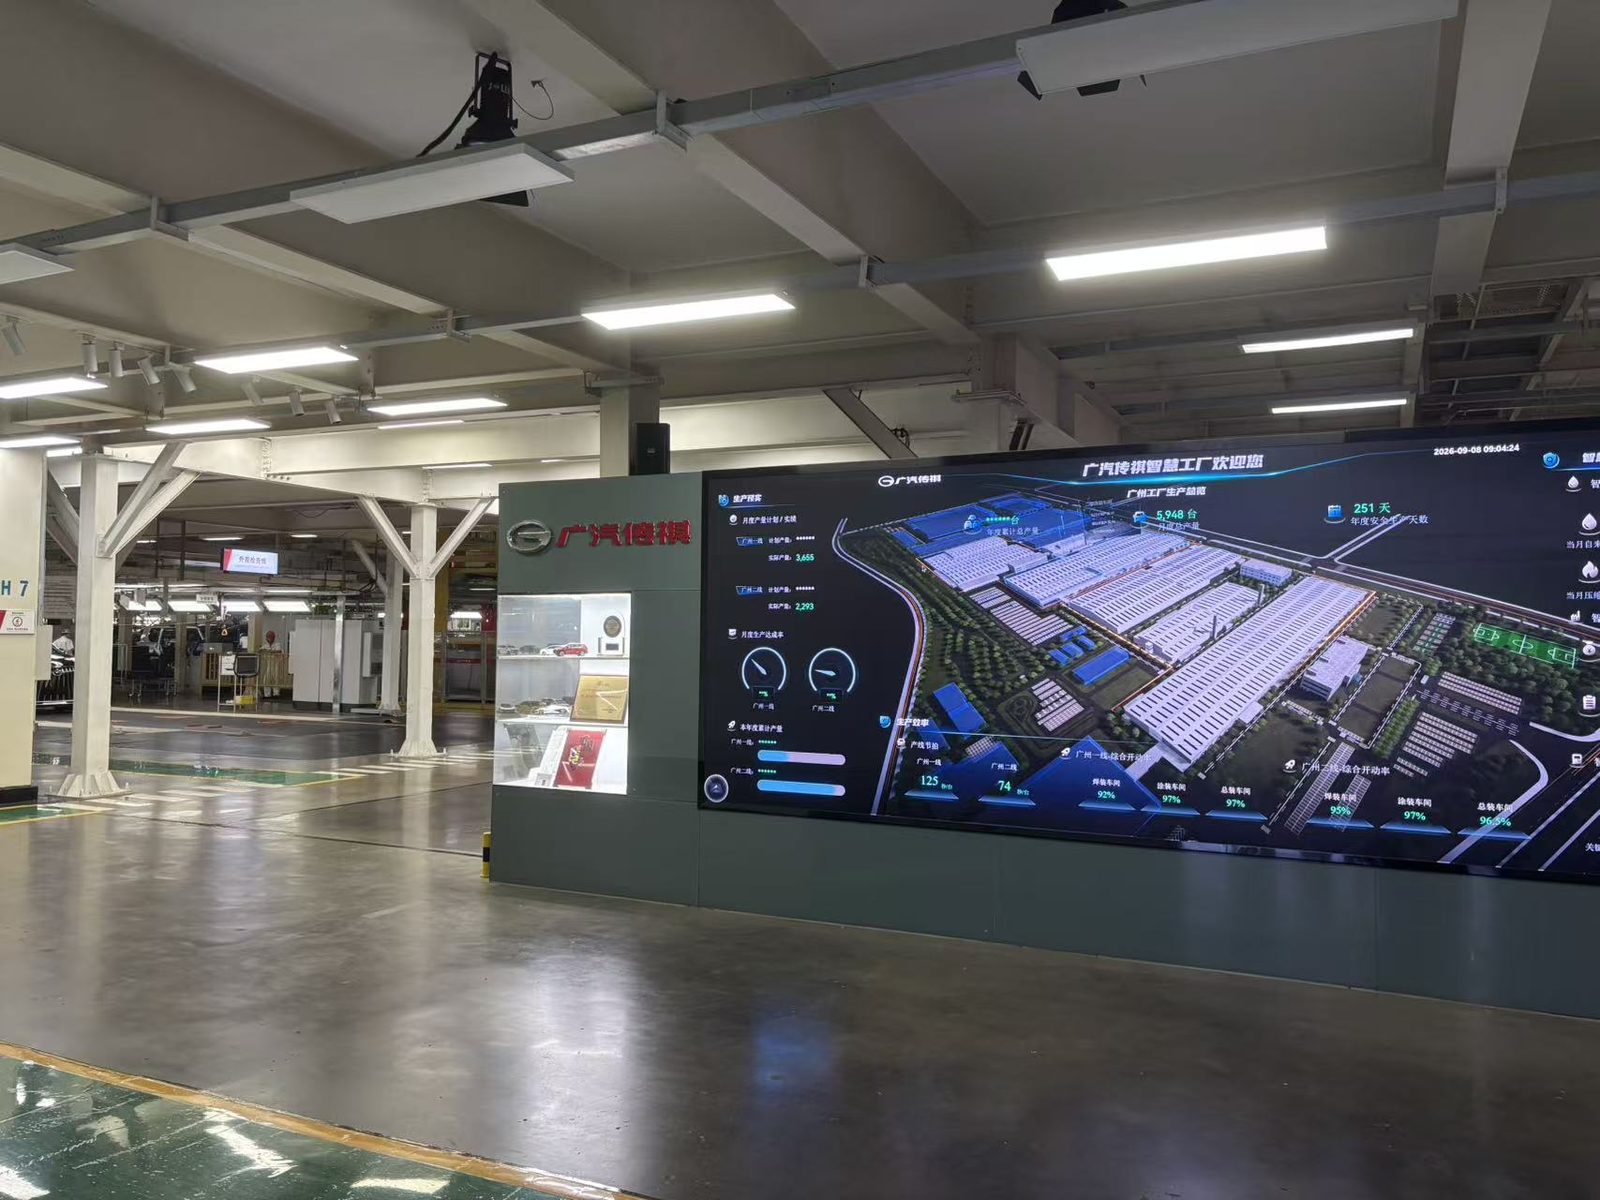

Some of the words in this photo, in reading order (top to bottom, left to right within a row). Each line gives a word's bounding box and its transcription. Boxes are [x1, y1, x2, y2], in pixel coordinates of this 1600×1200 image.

[1433, 446, 1482, 456] 2026-09-08
[1483, 443, 1520, 453] 09:04:24
[1082, 453, 1264, 477] 广汽传祺智慧工厂欢迎您
[1126, 486, 1207, 498] 广州工厂生产总览
[1354, 502, 1374, 514] 251
[1379, 502, 1391, 514] 天
[1157, 510, 1184, 521] 5,948
[1187, 509, 1198, 519] 台
[796, 553, 815, 563] 3,655
[1, 580, 11, 596] H
[20, 580, 29, 597] 7
[795, 602, 815, 612] 2,293
[921, 775, 939, 786] 125
[998, 780, 1012, 791] 74
[1097, 790, 1116, 799] 92%
[1221, 785, 1251, 795] 总装车间
[1162, 794, 1181, 804] 97%
[1226, 798, 1246, 808] 97%
[1330, 805, 1351, 815] 95%
[1477, 802, 1513, 813] 总装车间
[1404, 810, 1426, 821] 97%
[1479, 816, 1512, 827] 96.5%
